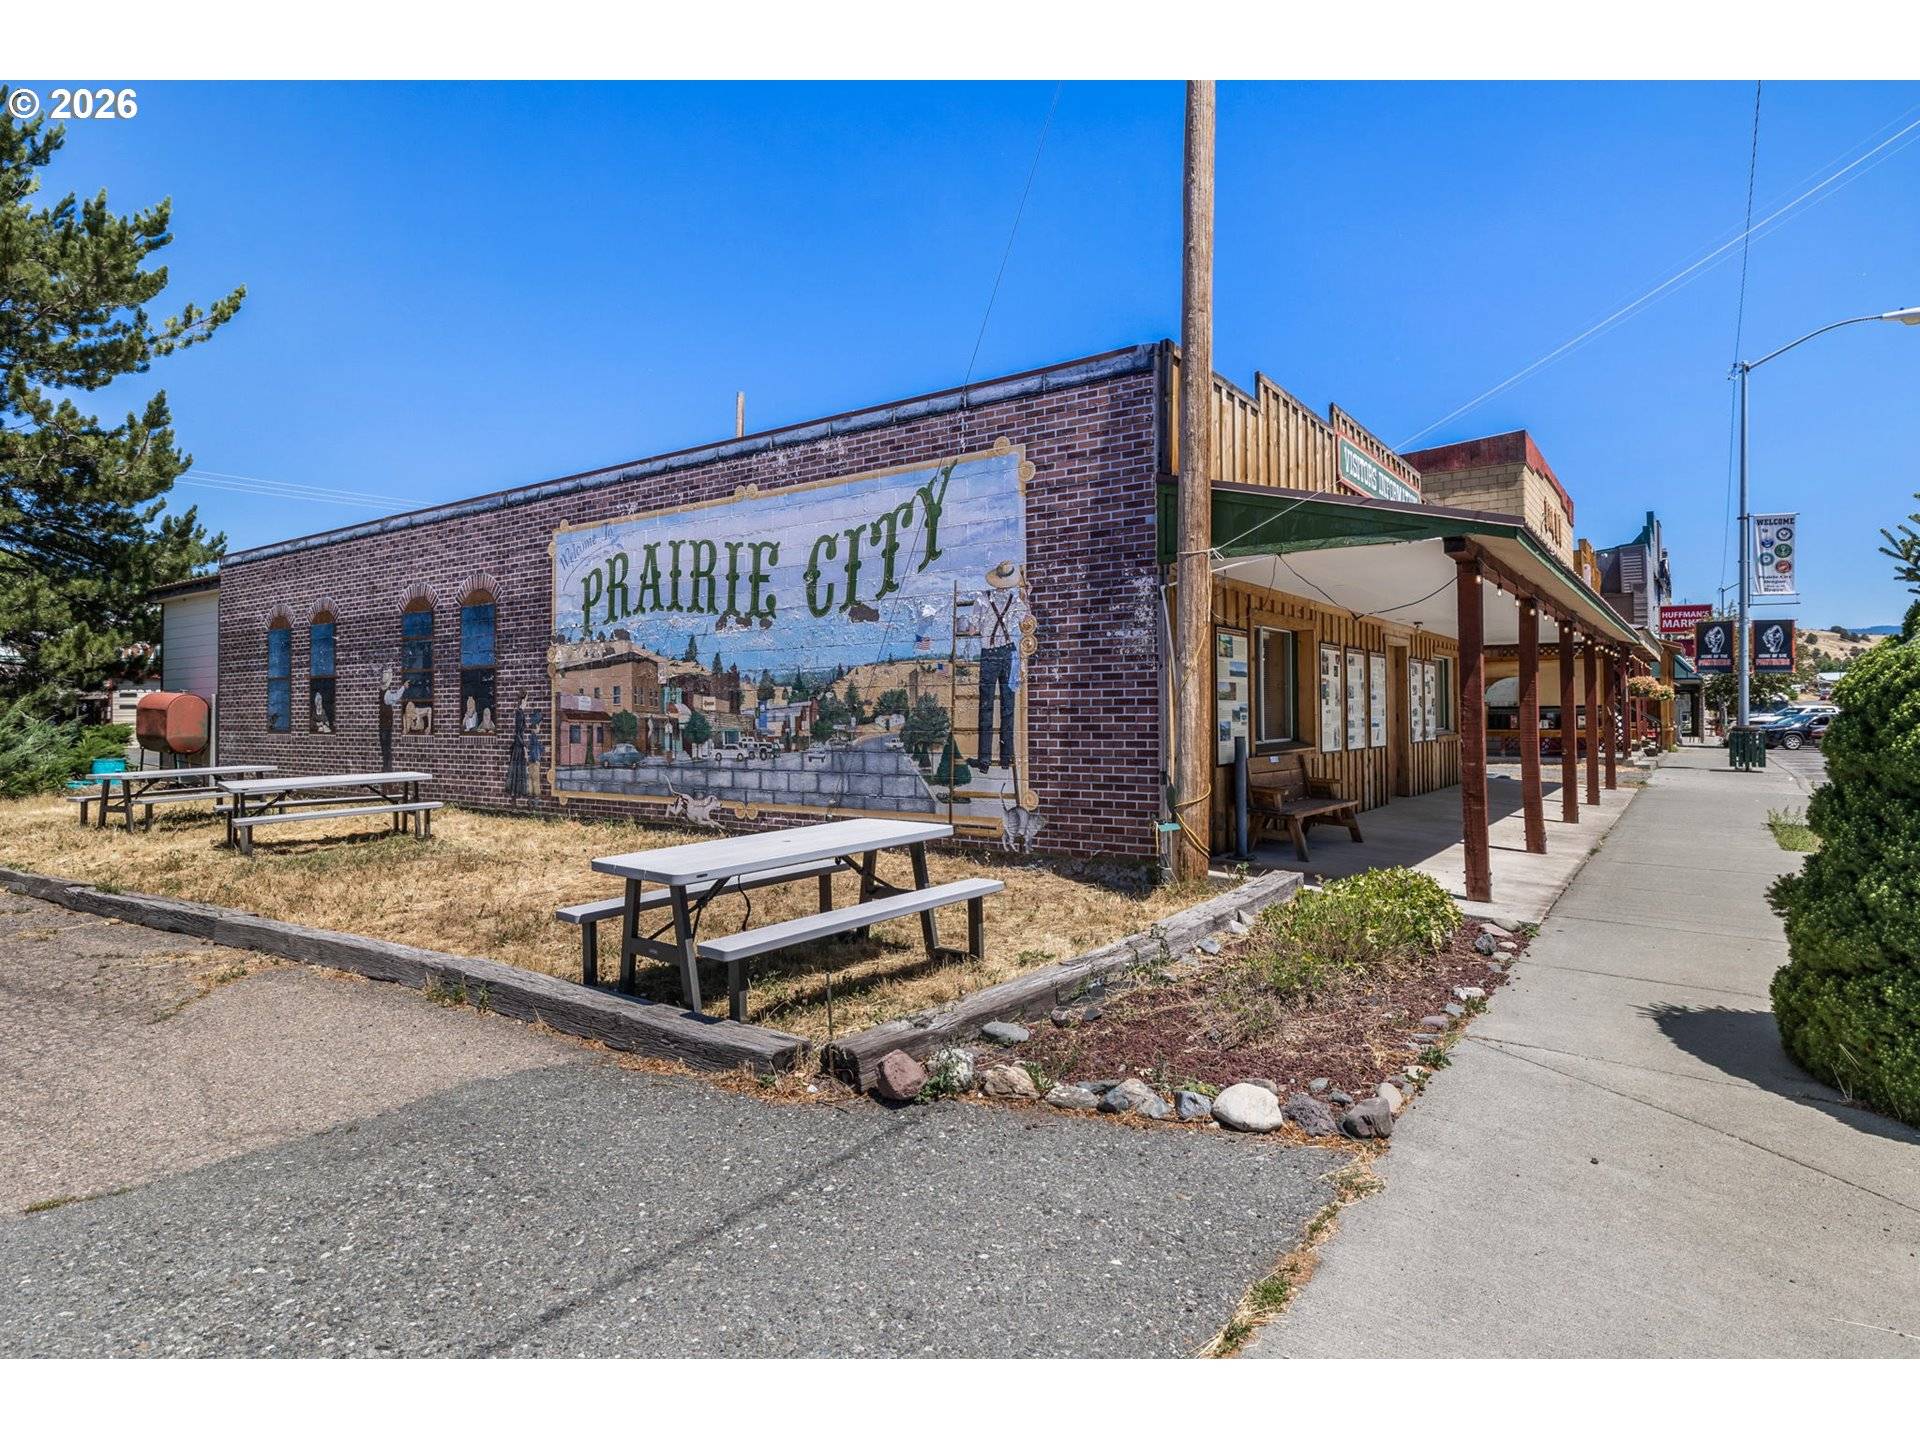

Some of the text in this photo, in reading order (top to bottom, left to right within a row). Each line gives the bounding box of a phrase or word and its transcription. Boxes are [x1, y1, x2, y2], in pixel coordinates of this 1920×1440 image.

[1343, 446, 1378, 491] VISITORS
[1756, 517, 1795, 526] WELCOME
[559, 533, 598, 571] Welcome
[581, 459, 959, 637] PRAIRIE CITY
[1662, 610, 1710, 619] HUFFMAN'S
[1662, 618, 1701, 628] MARK
